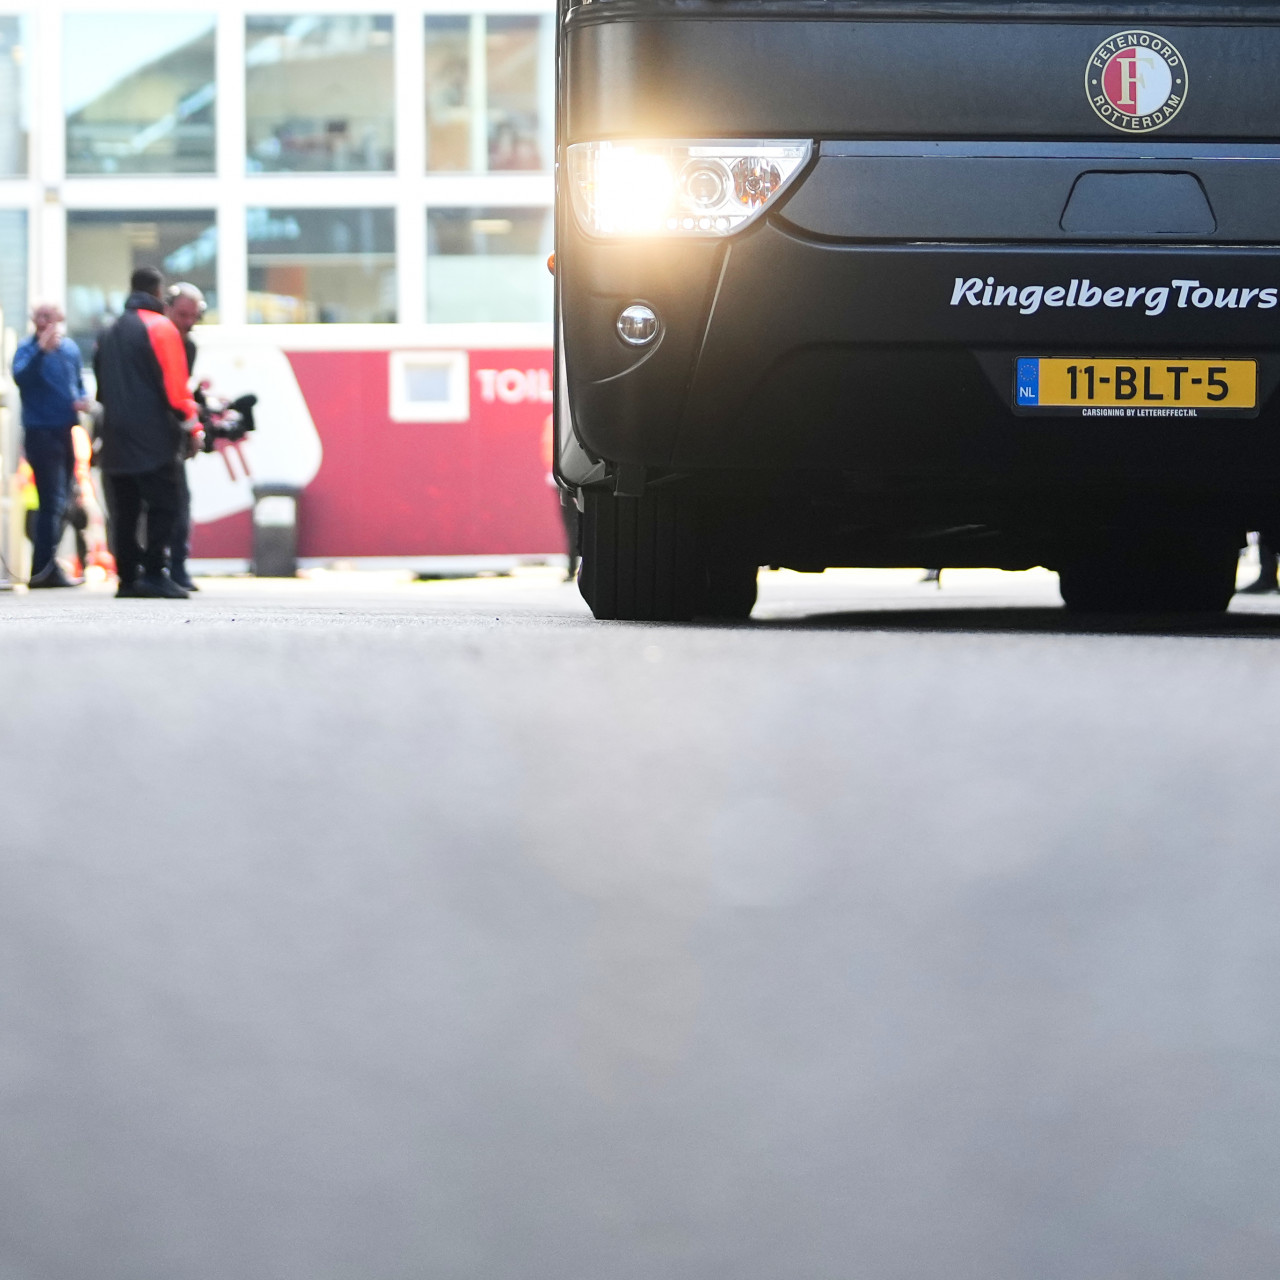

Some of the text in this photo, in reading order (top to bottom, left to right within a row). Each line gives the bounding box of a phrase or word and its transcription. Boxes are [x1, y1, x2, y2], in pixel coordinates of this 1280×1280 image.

[1093, 34, 1179, 68] FEYENOORD
[1093, 93, 1181, 129] ROTTERDAM
[1020, 365, 1230, 402] NL 11-BLT-5
[1082, 408, 1198, 418] CARSIGNING BY LETTEREFFECT.NL
